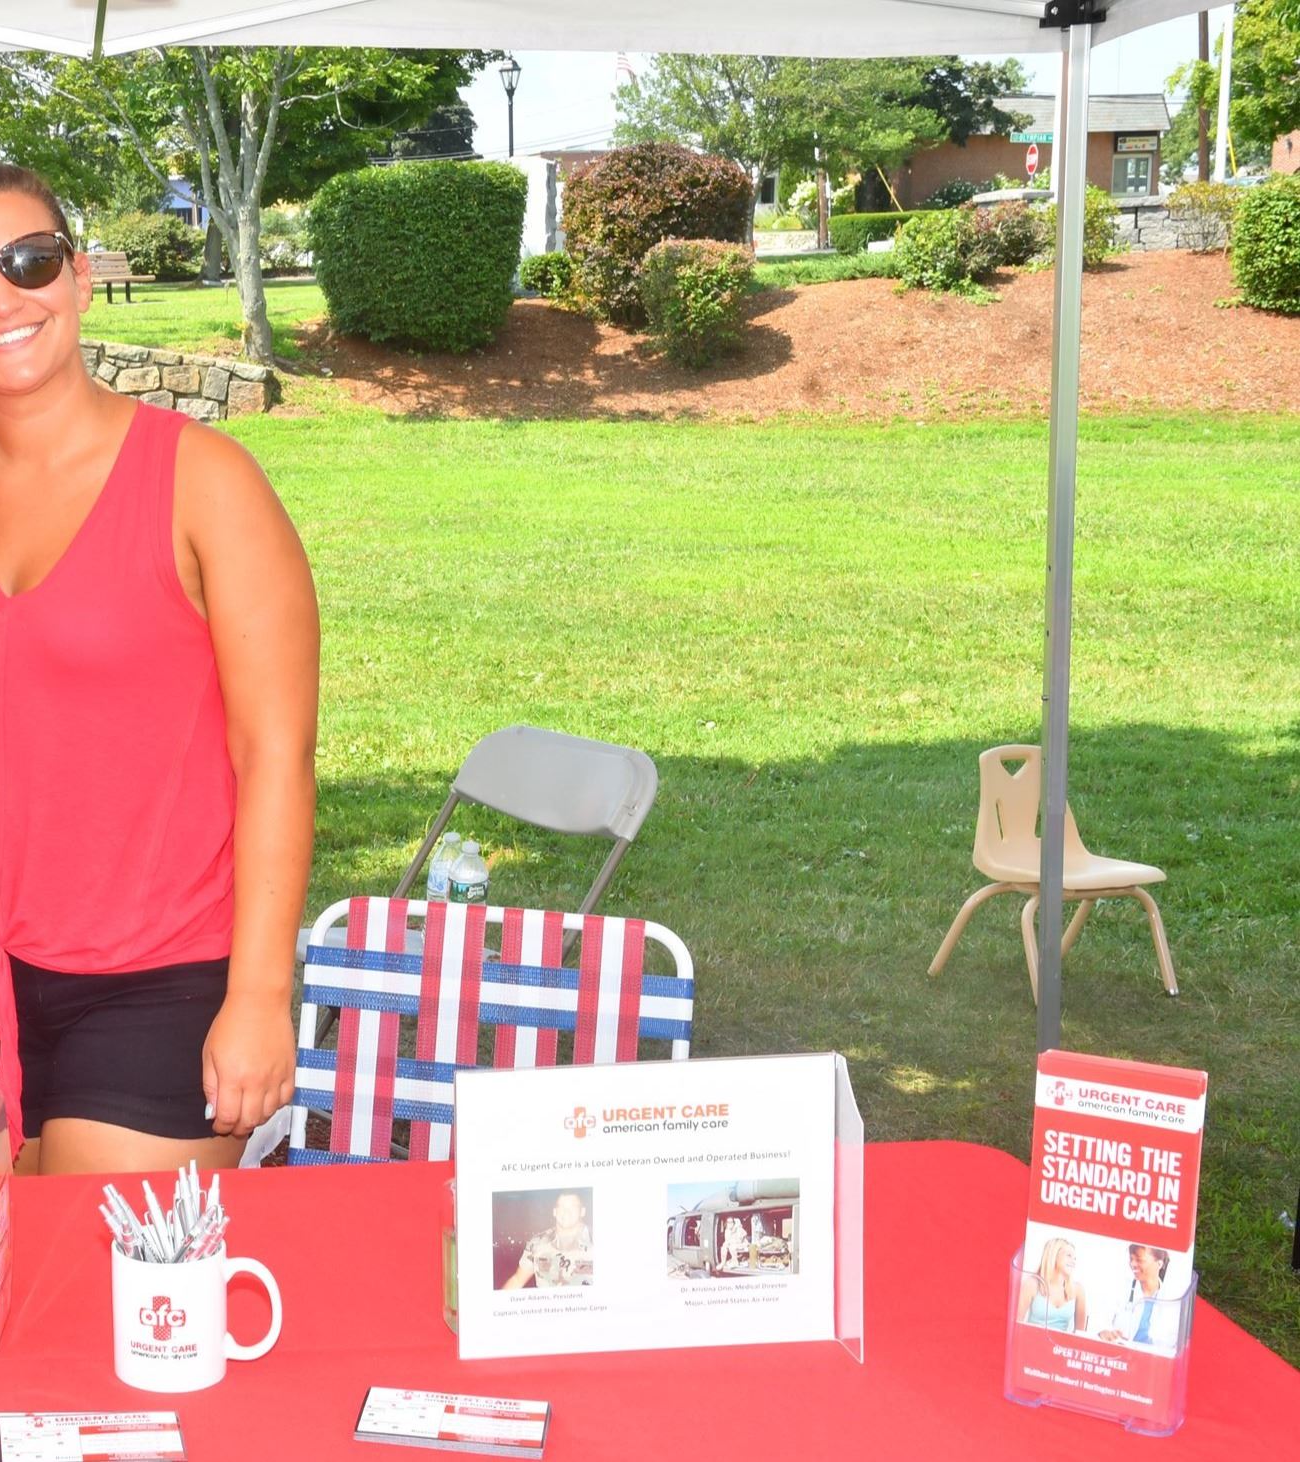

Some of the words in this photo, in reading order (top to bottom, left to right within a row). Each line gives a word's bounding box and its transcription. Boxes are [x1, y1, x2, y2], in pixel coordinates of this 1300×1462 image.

[602, 1106, 676, 1122] URGENT
[681, 1104, 729, 1118] CARE
[1078, 1100, 1126, 1114] american
[1129, 1107, 1159, 1121] family
[1161, 1116, 1185, 1124] care
[1079, 1088, 1140, 1107] URGENT
[1145, 1099, 1186, 1115] CARE
[602, 1122, 659, 1134] american
[663, 1120, 699, 1132] family
[701, 1119, 728, 1129] care
[502, 1163, 518, 1171] AFC
[521, 1162, 550, 1172] Urgent
[552, 1161, 572, 1170] Care
[575, 1160, 581, 1168] is
[592, 1158, 613, 1168] Local
[617, 1157, 650, 1166] Veteran
[654, 1155, 684, 1165] Owned
[688, 1154, 703, 1163] and
[706, 1152, 747, 1164] Operated
[750, 1150, 791, 1160] Business!
[1044, 1129, 1132, 1167] SETTING
[1141, 1146, 1182, 1176] THE
[1042, 1155, 1151, 1196] STANDARD
[1157, 1176, 1180, 1202] IN
[1041, 1180, 1120, 1216] URGENT
[1123, 1196, 1178, 1229] CARE
[141, 1303, 182, 1326] afc
[131, 1340, 167, 1353] URGENT
[172, 1344, 197, 1353] CARE
[1053, 1344, 1073, 1358] OPEN
[1081, 1351, 1099, 1363] DAYS
[1107, 1358, 1128, 1371] WEEK
[1084, 1362, 1093, 1372] TO
